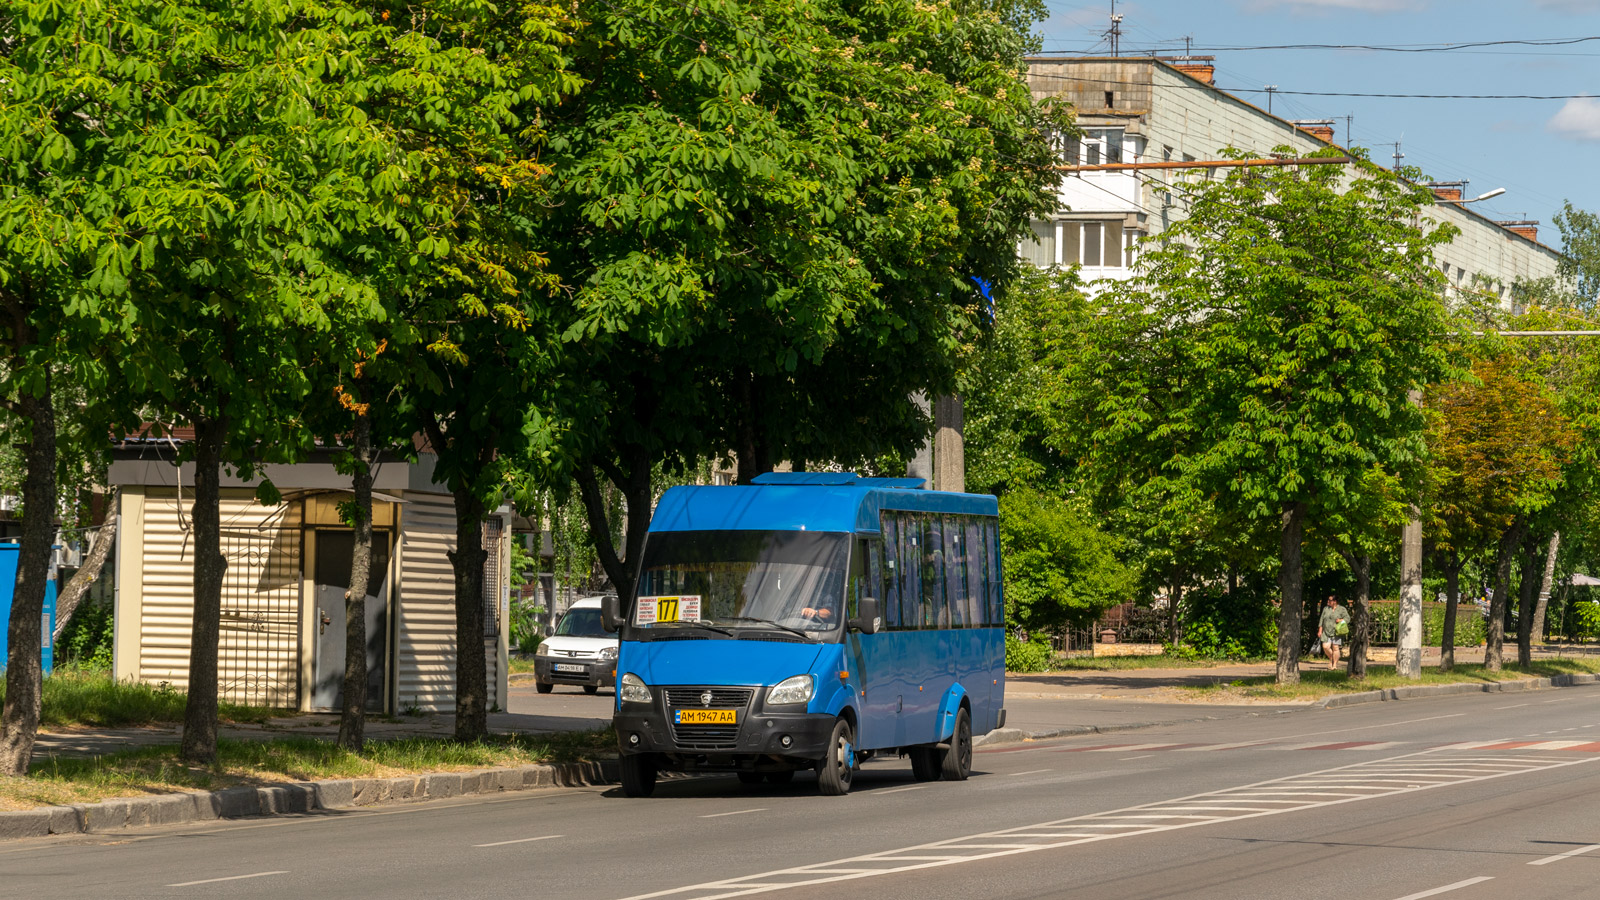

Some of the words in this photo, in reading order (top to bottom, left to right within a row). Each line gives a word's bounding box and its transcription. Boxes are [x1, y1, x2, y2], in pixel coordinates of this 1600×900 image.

[658, 599, 679, 620] 177
[681, 711, 695, 722] AM
[696, 711, 718, 722] 1947
[720, 711, 734, 722] AA
